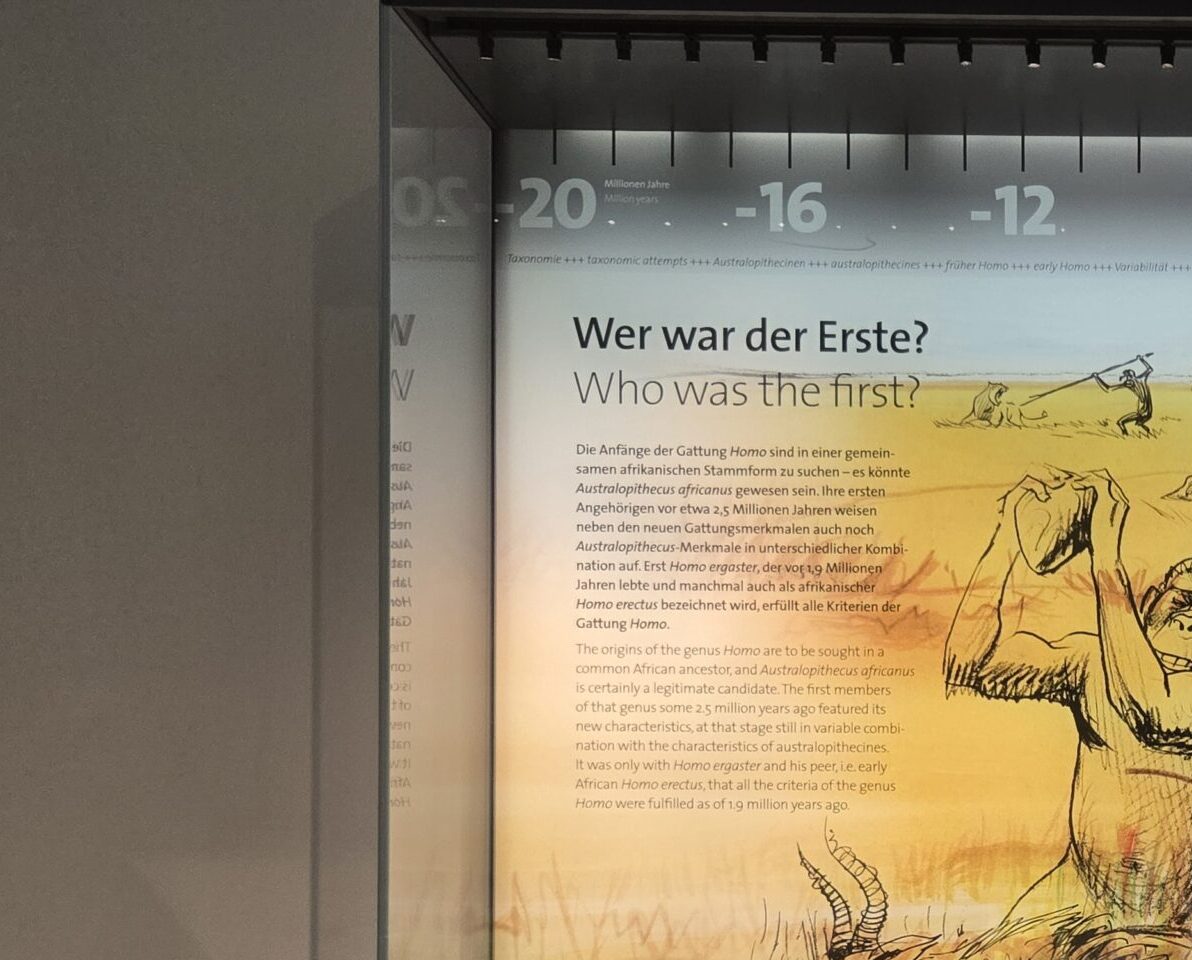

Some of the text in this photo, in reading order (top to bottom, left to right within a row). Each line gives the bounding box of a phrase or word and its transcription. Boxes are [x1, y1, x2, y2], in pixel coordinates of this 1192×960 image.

[604, 179, 671, 189] Millionen Jahre
[495, 177, 597, 229] -20
[735, 182, 827, 233] -16
[970, 185, 1056, 236] -12
[507, 252, 562, 264] Taxonomie
[586, 253, 641, 265] taxonomic
[642, 254, 687, 268] attempts
[712, 255, 805, 269] Australopithecinen
[830, 257, 920, 271] australopithecines
[943, 259, 976, 270] früher
[978, 259, 1009, 270] Homo
[1033, 261, 1058, 274] early
[1059, 261, 1090, 272] Homo
[1114, 261, 1168, 272] Variabilität
[573, 316, 930, 354] Wer war der Erste?
[573, 370, 921, 408] Who was the first?
[576, 443, 895, 462] Die Anfänge der Gattung Homo sind in einer gemein-
[576, 463, 910, 478] samen afrikanischen Stammform zu suchen es könnte
[575, 481, 885, 499] Australopithecus africanus gewesen sein. Ihre ersten
[576, 501, 876, 518] Angehörigen vor etwa 2,5 Millionen Jahren weisen
[575, 662, 914, 679] common African ancestor, and Australopithecus africanus
[576, 681, 891, 698] is certainly a legitimate candidate. The first members
[576, 738, 888, 756] nation with the characteristics of australopithecines.
